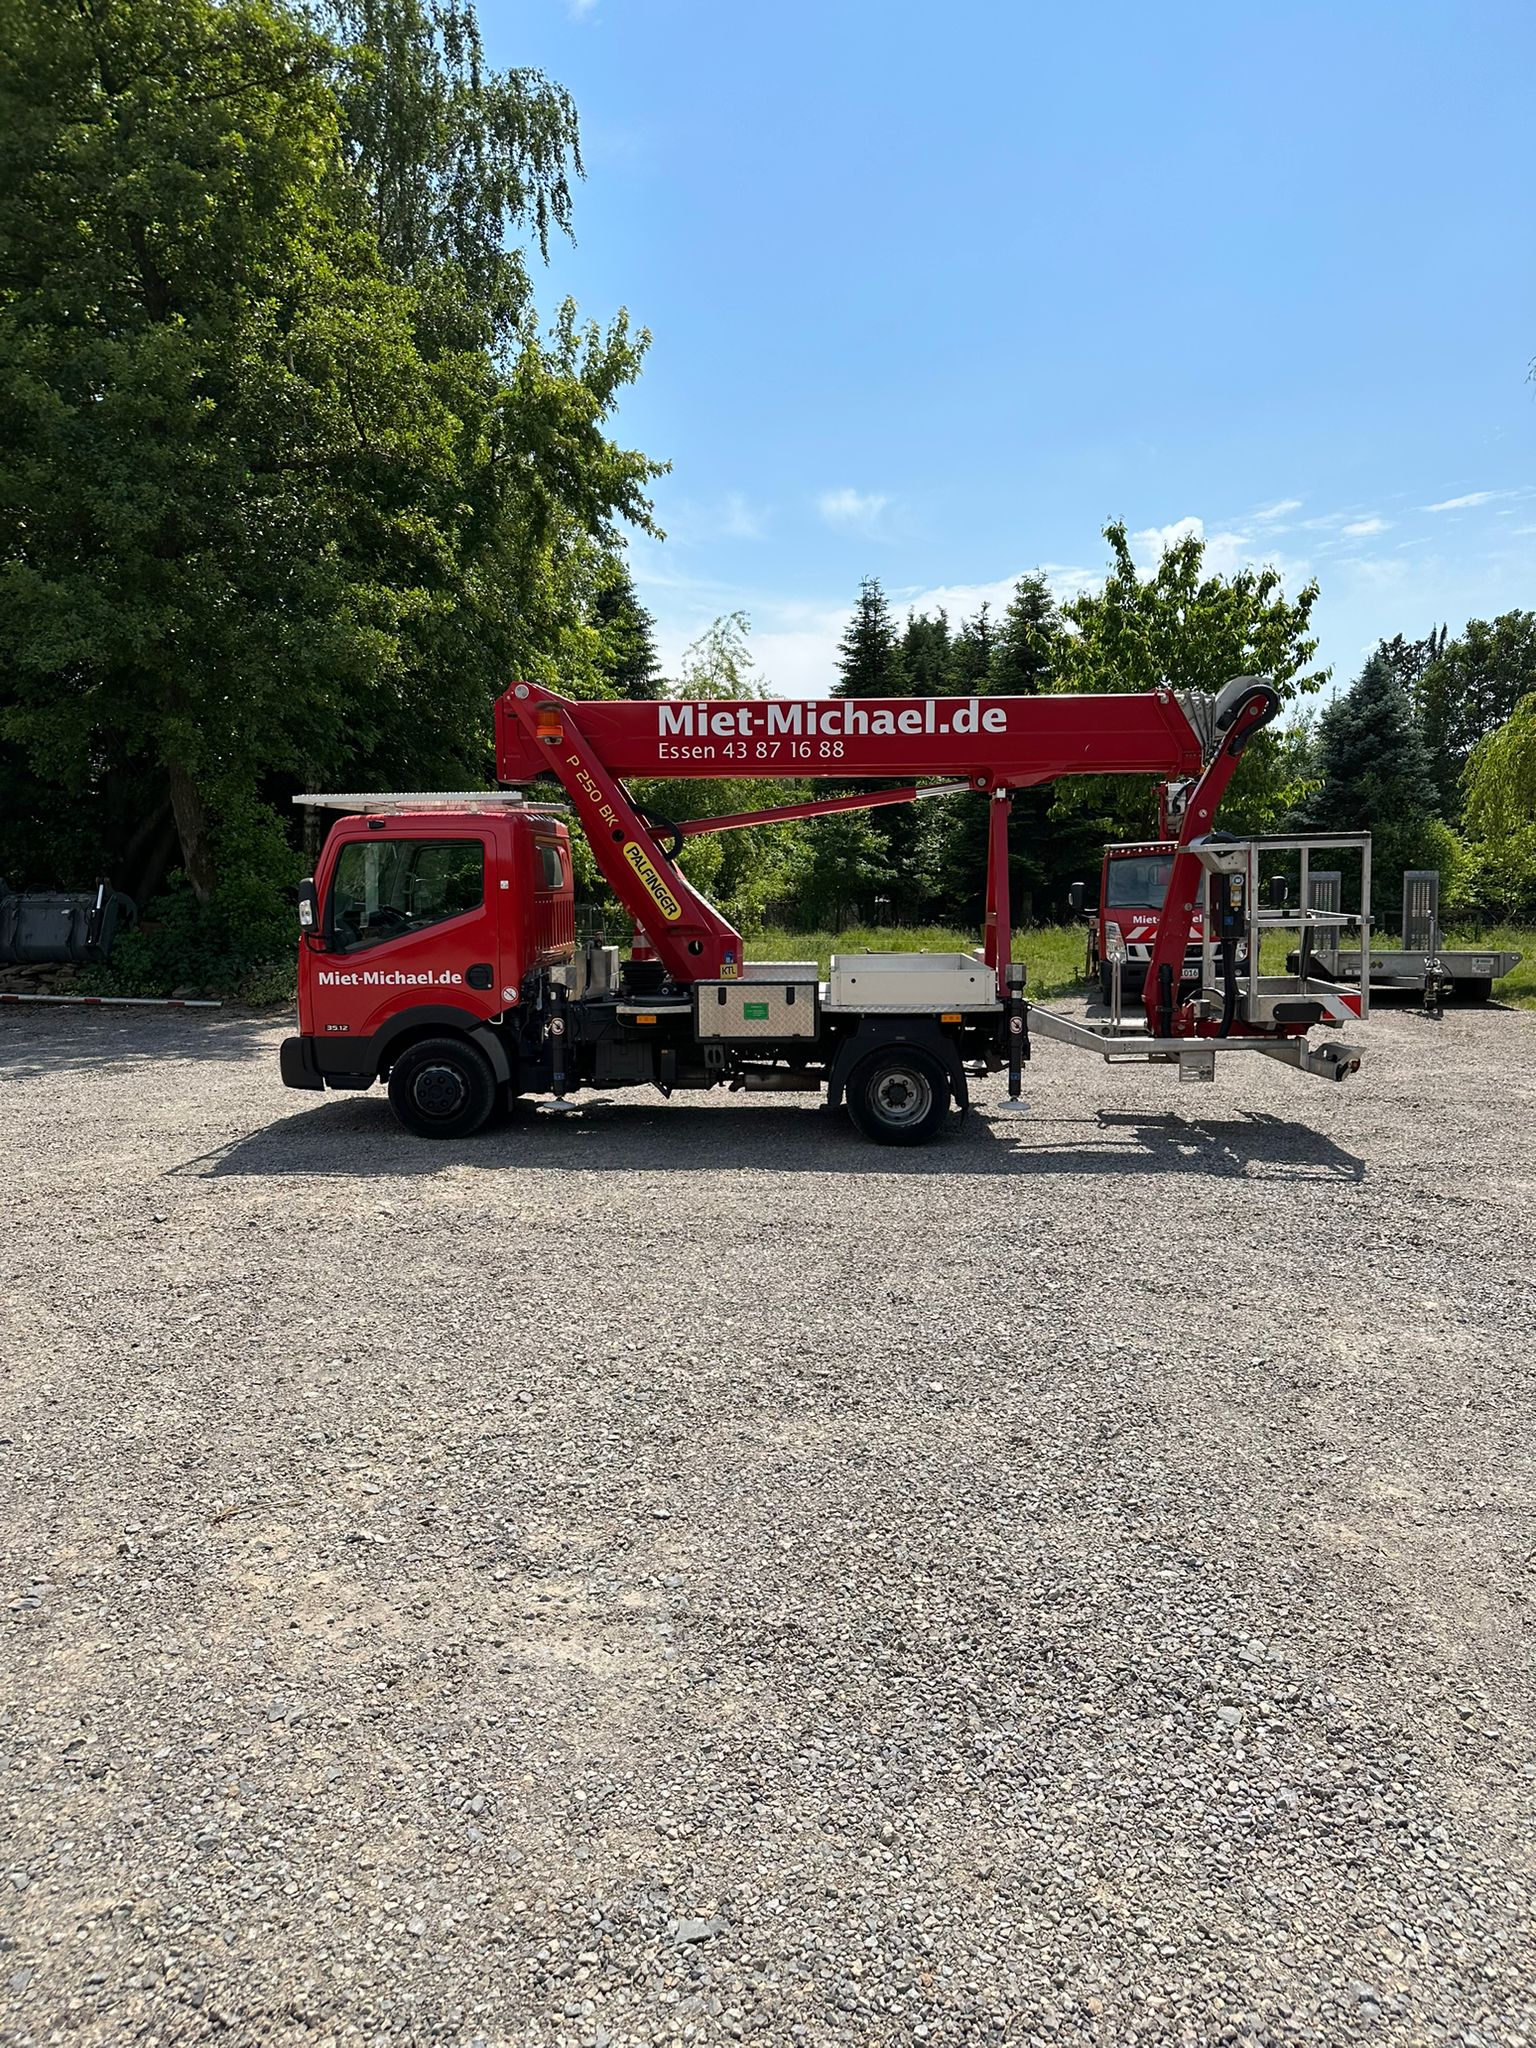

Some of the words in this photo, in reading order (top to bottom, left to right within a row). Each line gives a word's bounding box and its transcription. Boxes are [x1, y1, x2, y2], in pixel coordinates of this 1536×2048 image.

[658, 699, 1007, 737] Miet-Michael.de
[658, 742, 715, 759] Essen
[722, 742, 747, 759] 43
[755, 741, 781, 758] 87
[790, 741, 811, 758] 16
[819, 741, 844, 758] 88
[566, 754, 580, 767] P
[575, 769, 603, 803] 250
[599, 804, 620, 828] BK
[626, 845, 678, 917] PALFINGER
[318, 970, 463, 986] Miet-Michael.de
[721, 966, 736, 975] KTL
